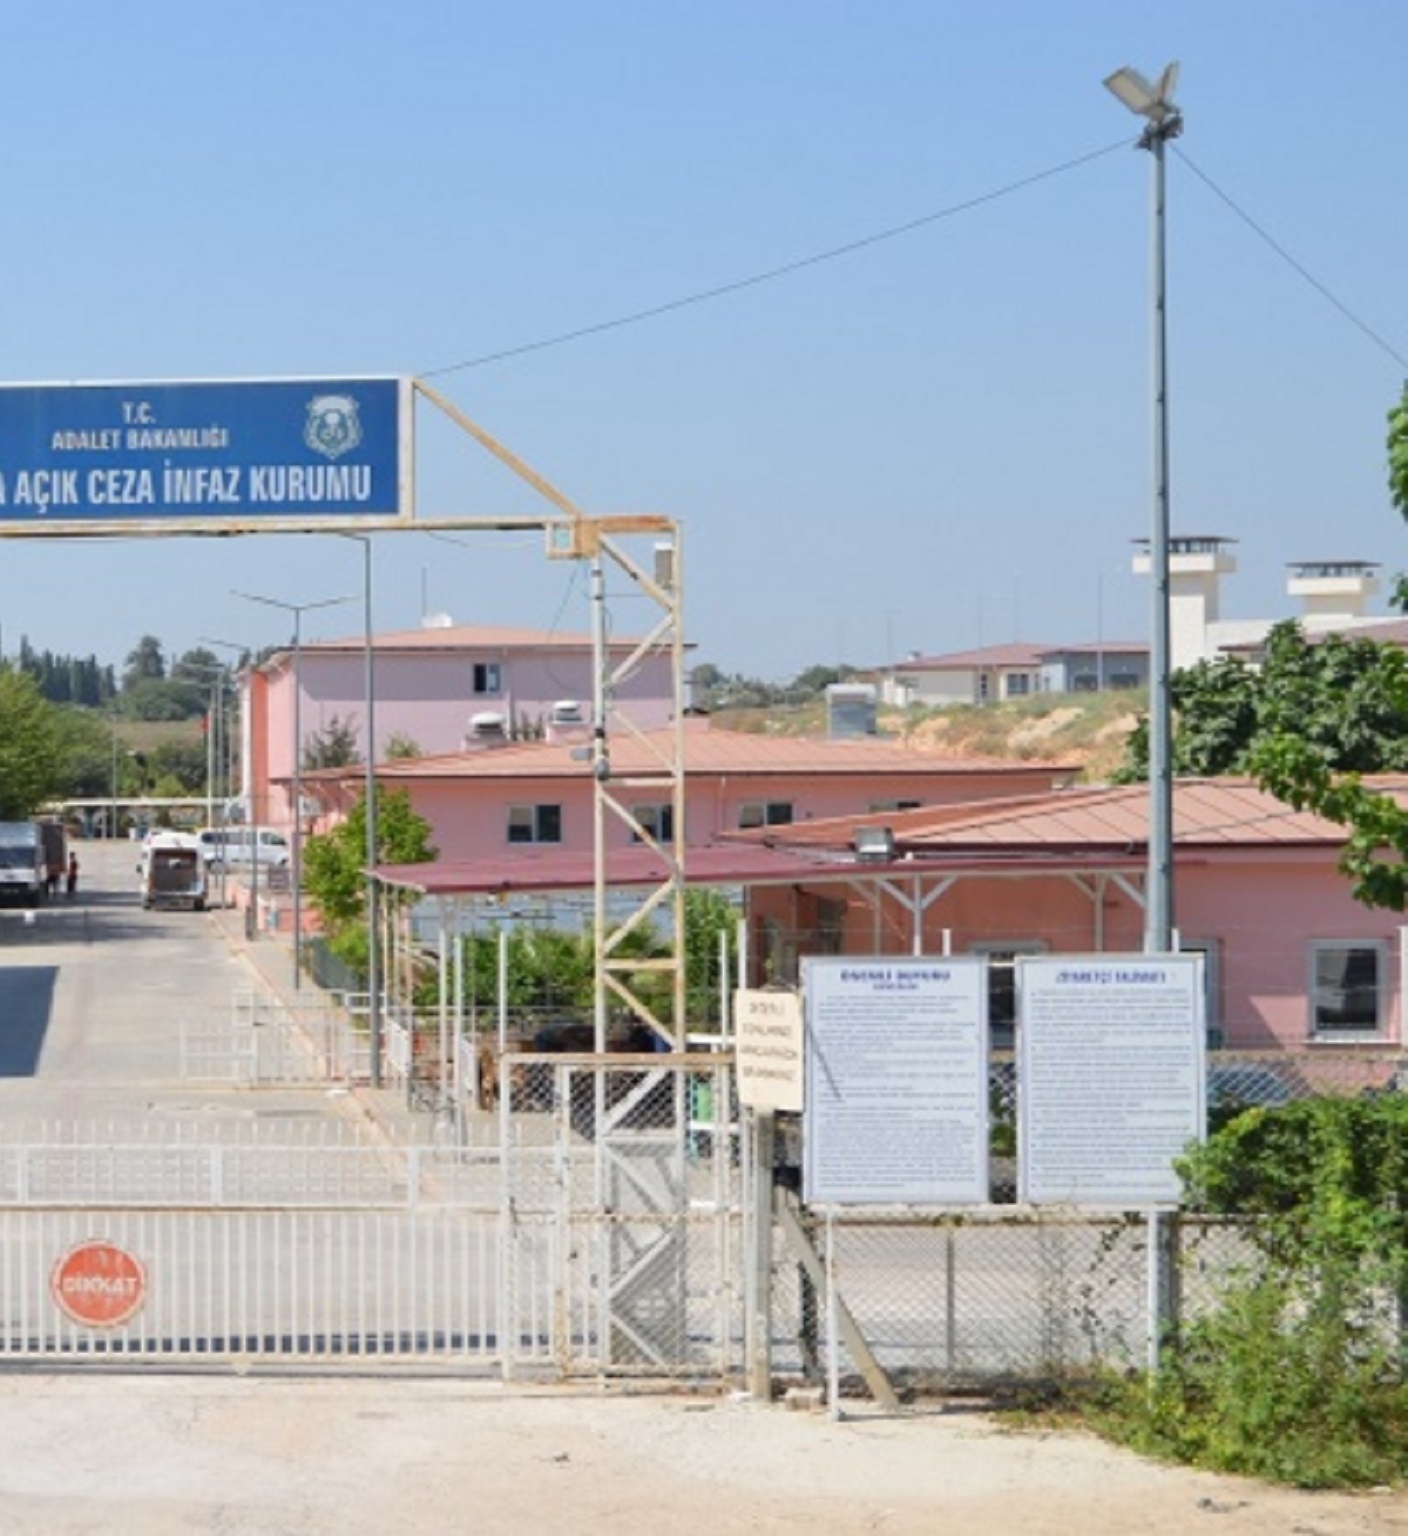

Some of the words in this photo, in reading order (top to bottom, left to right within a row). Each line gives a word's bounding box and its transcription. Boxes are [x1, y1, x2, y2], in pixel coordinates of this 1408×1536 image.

[122, 401, 156, 424] T.C.
[52, 428, 121, 450] ADALET
[126, 423, 229, 449] BAKANLIĞI
[13, 469, 78, 514] AÇIK
[87, 468, 155, 505] CEZA
[163, 458, 241, 504] İNFAZ
[249, 464, 371, 501] KURUMU
